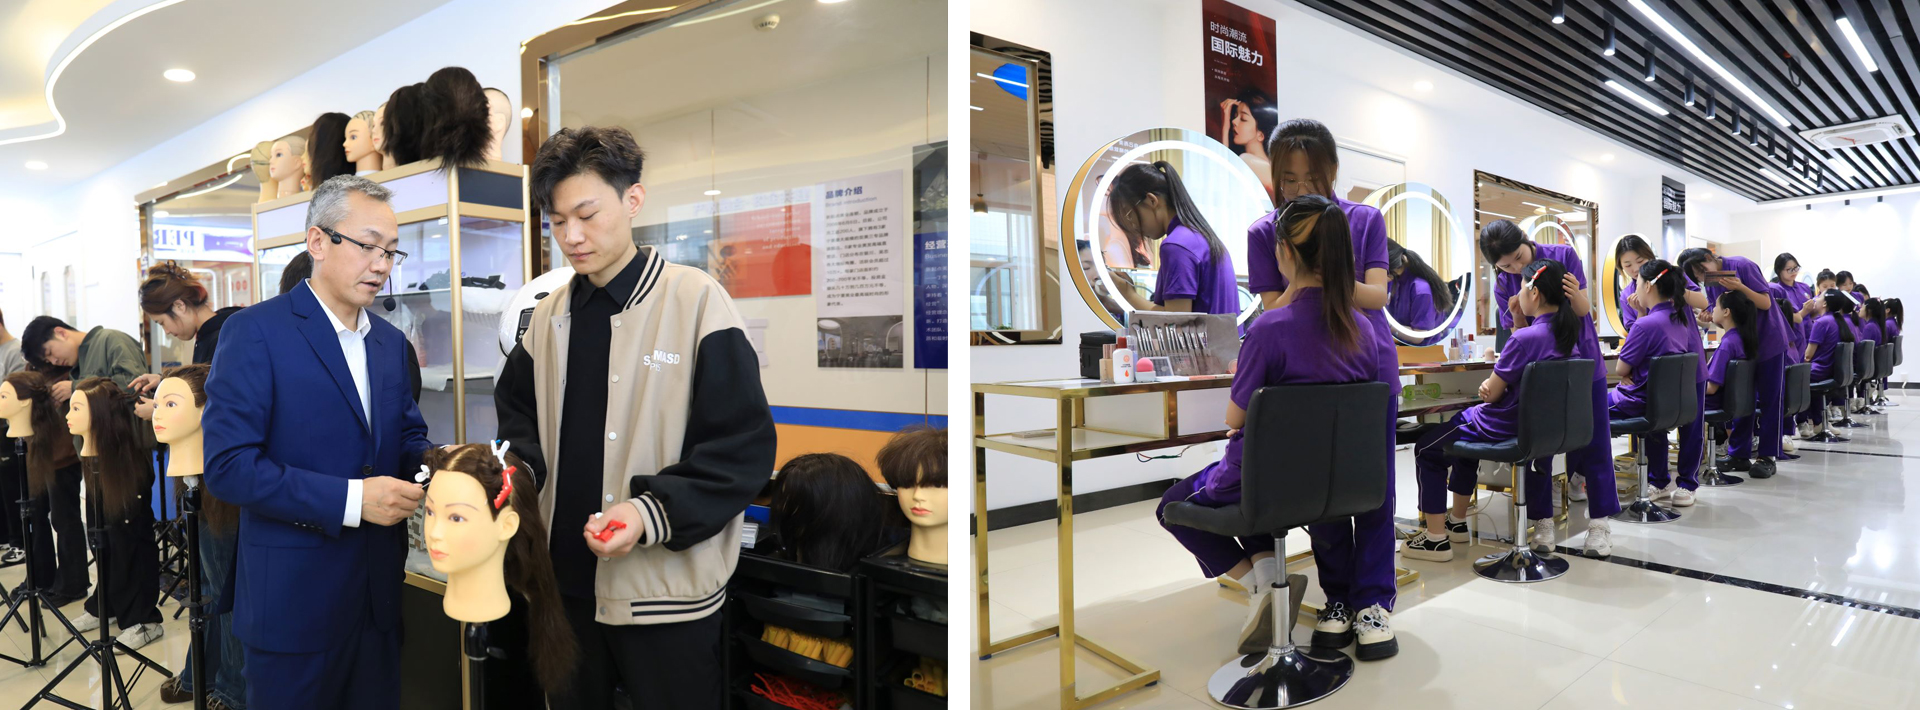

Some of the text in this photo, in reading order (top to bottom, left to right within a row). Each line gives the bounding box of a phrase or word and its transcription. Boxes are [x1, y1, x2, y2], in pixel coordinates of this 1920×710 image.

[1210, 21, 1248, 44] 时尚潮流
[1211, 36, 1263, 67] 国际魅力
[825, 186, 863, 199] 品牌介绍
[925, 240, 948, 250] 经营
